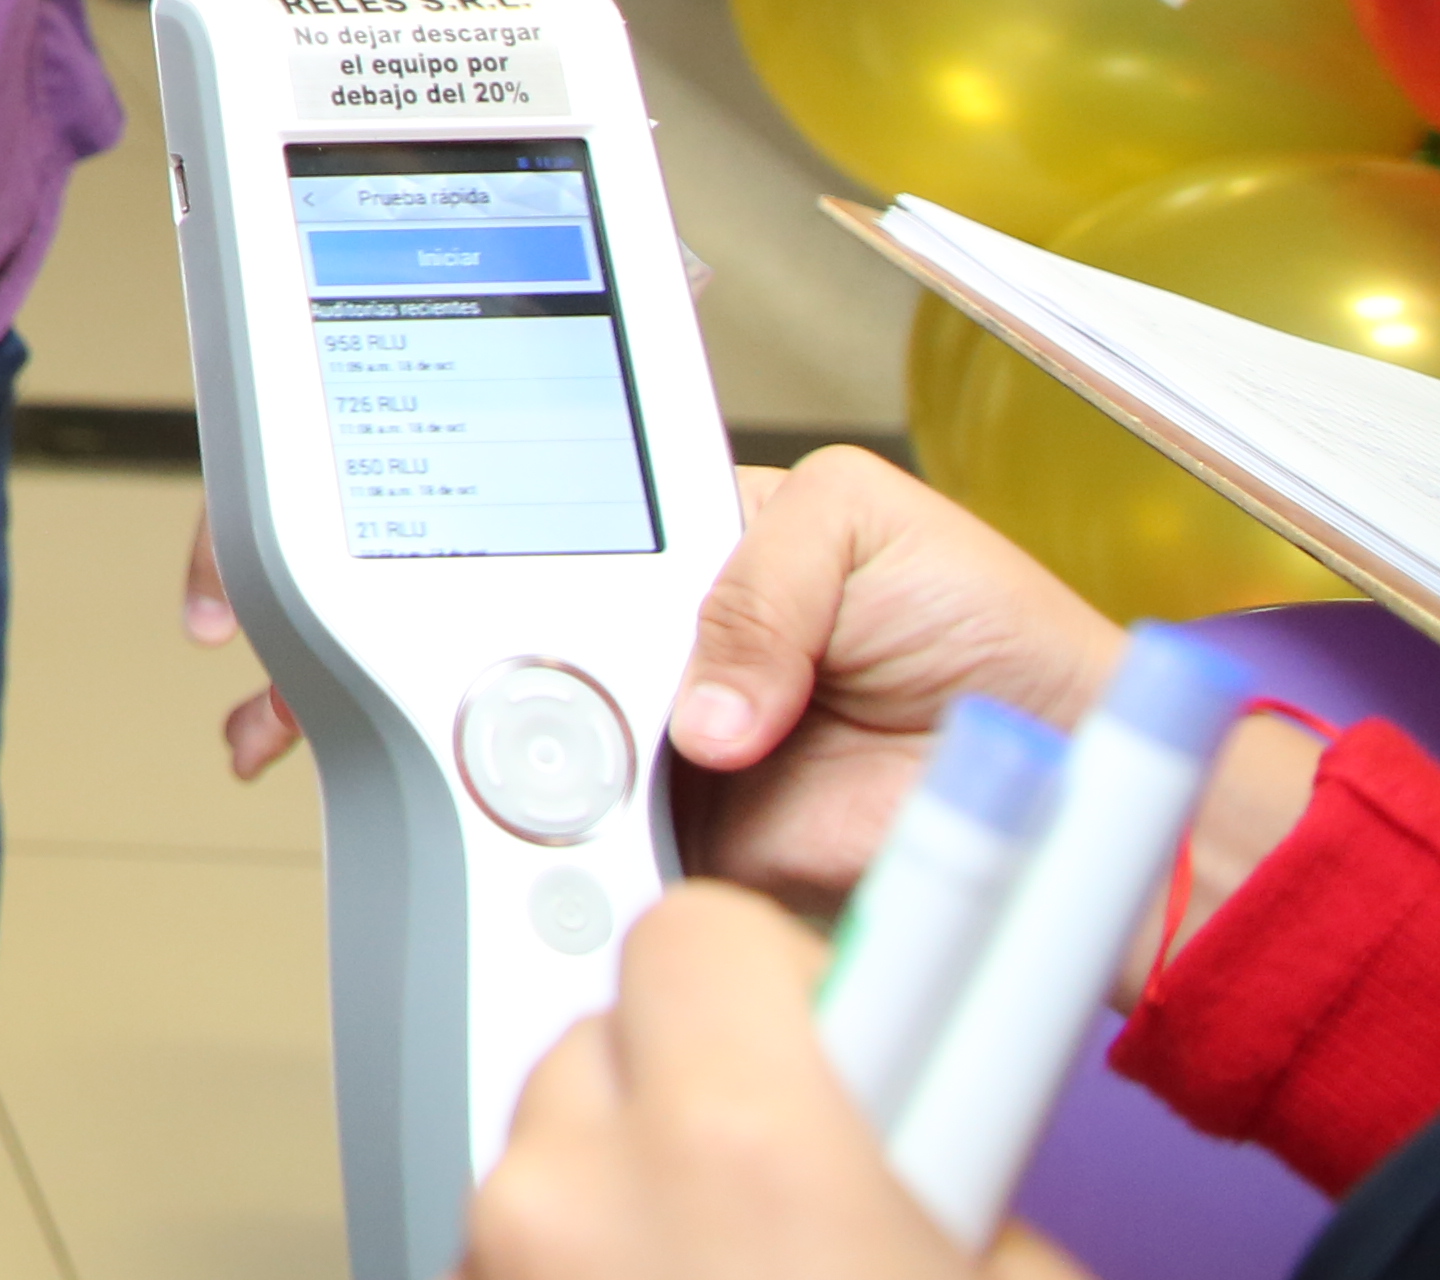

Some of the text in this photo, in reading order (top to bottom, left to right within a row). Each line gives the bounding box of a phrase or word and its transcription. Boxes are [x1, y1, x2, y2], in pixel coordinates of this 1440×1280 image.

[293, 23, 542, 50] No dejar descargar
[340, 53, 509, 79] el equipo por
[330, 80, 531, 110] debajo del 20%
[357, 187, 491, 209] Prueba rápida
[417, 247, 482, 268] Iniciar
[400, 298, 482, 316] recientes
[367, 333, 408, 351] RLU
[378, 395, 419, 412] RLU
[389, 457, 429, 475] RLU
[356, 521, 427, 539] 21 RLU
